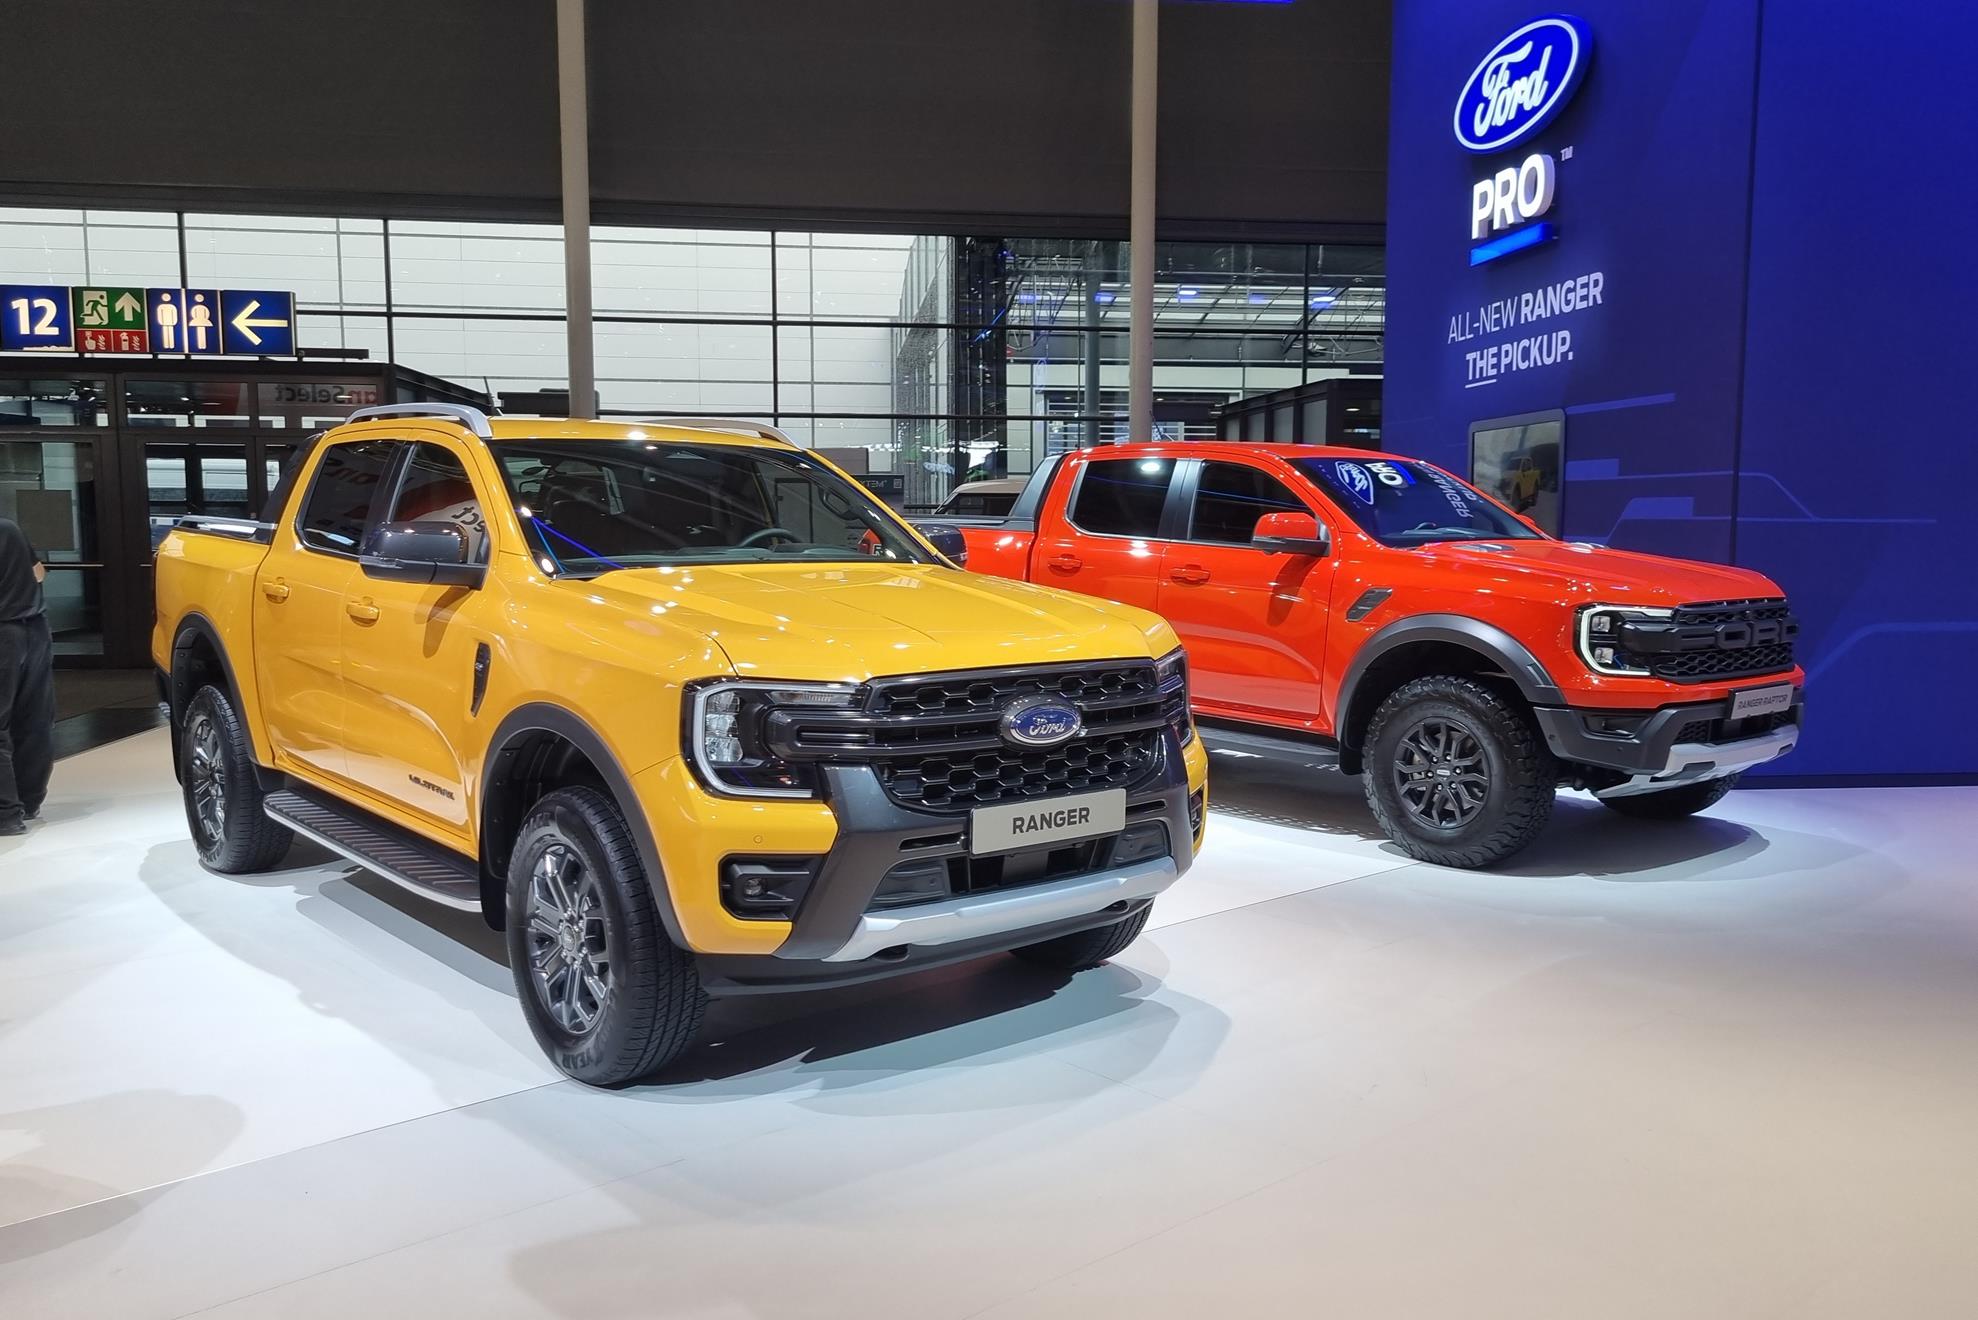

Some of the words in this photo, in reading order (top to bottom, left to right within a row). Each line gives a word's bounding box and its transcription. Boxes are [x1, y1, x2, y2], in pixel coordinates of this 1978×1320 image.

[1474, 41, 1552, 137] Ford
[1472, 154, 1553, 239] PRO
[11, 298, 60, 336] 12
[1447, 296, 1518, 344] ALL-NEW
[1520, 271, 1604, 324] RANGER
[1465, 346, 1498, 381] THE
[1500, 330, 1574, 373] PICKUP.
[1029, 716, 1067, 736] Ford
[1012, 806, 1090, 835] RANGER
